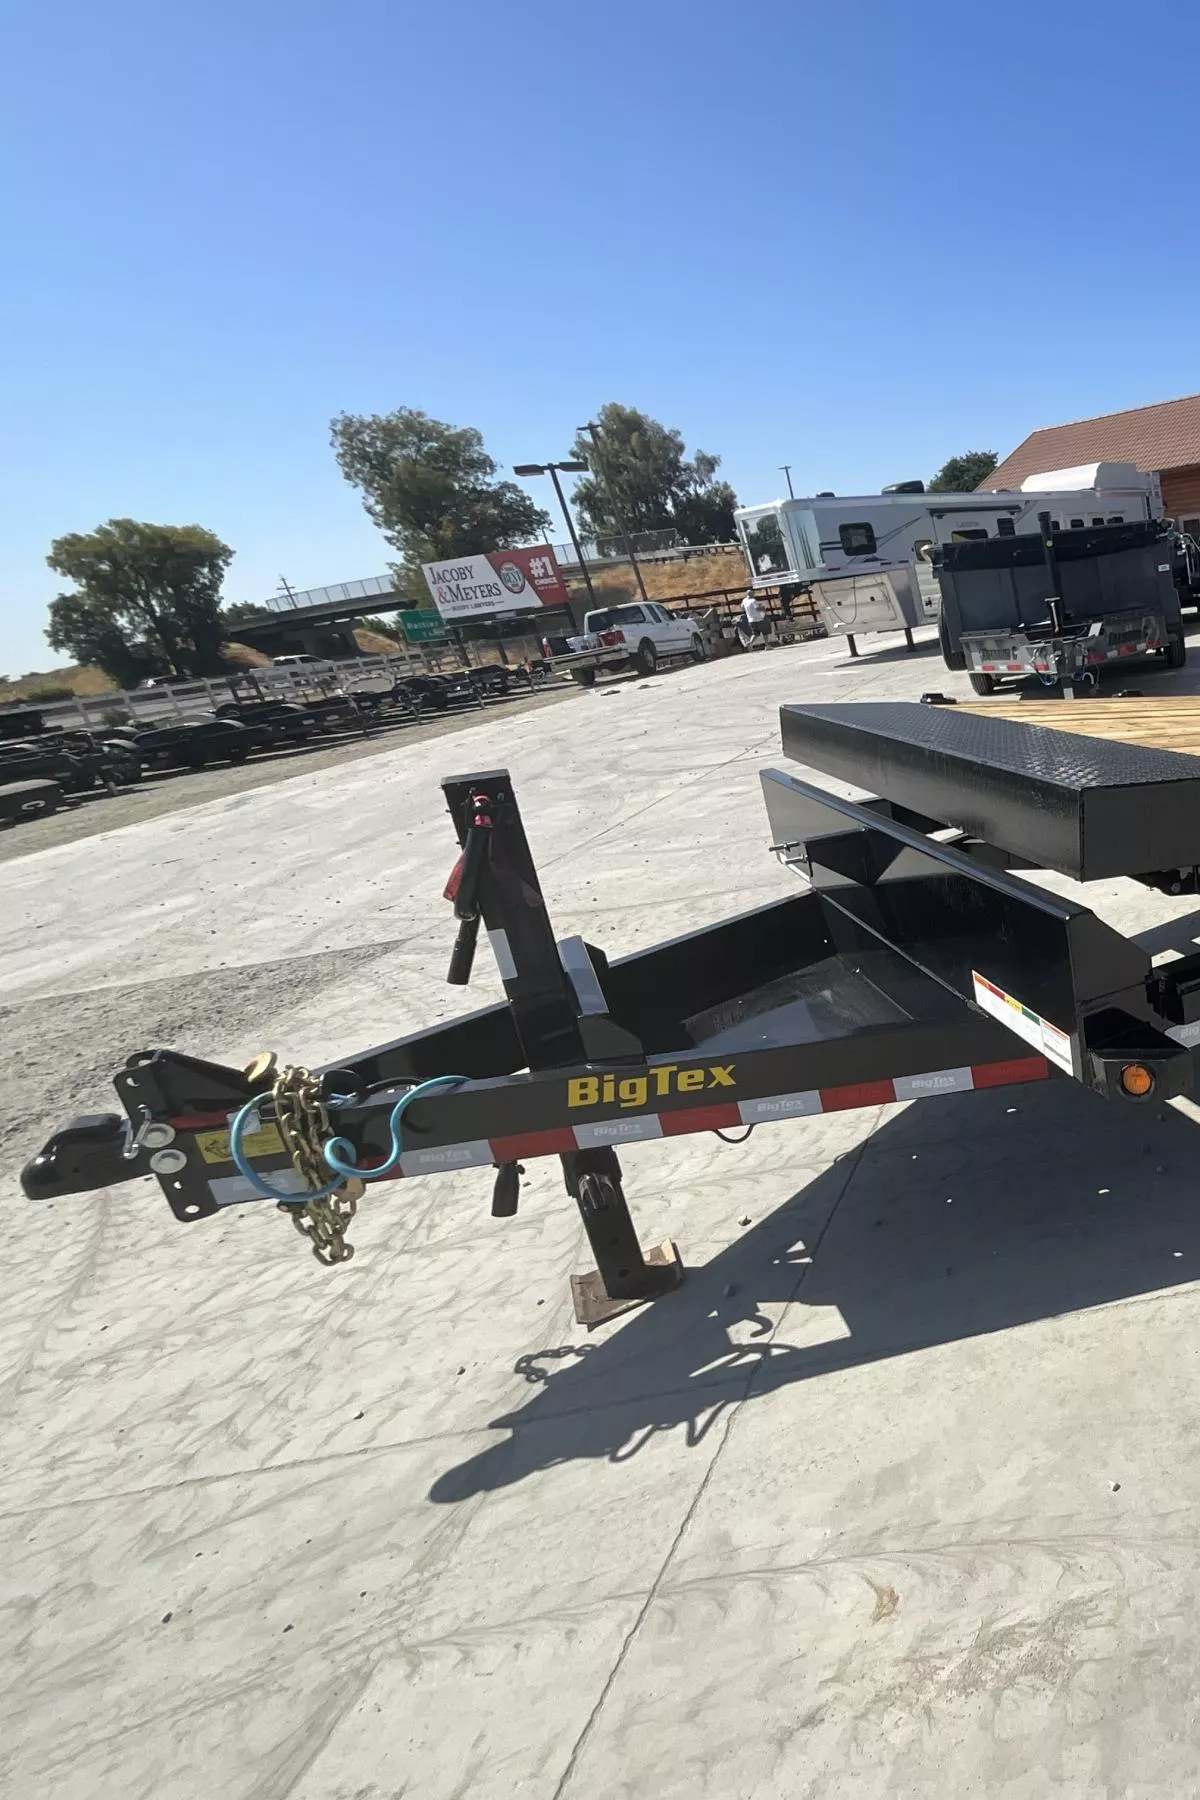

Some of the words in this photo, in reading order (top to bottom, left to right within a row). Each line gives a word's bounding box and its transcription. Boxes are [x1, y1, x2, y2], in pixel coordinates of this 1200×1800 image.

[428, 565, 474, 586] JACOBY
[529, 556, 554, 578] #1
[567, 1064, 737, 1108] BigTex
